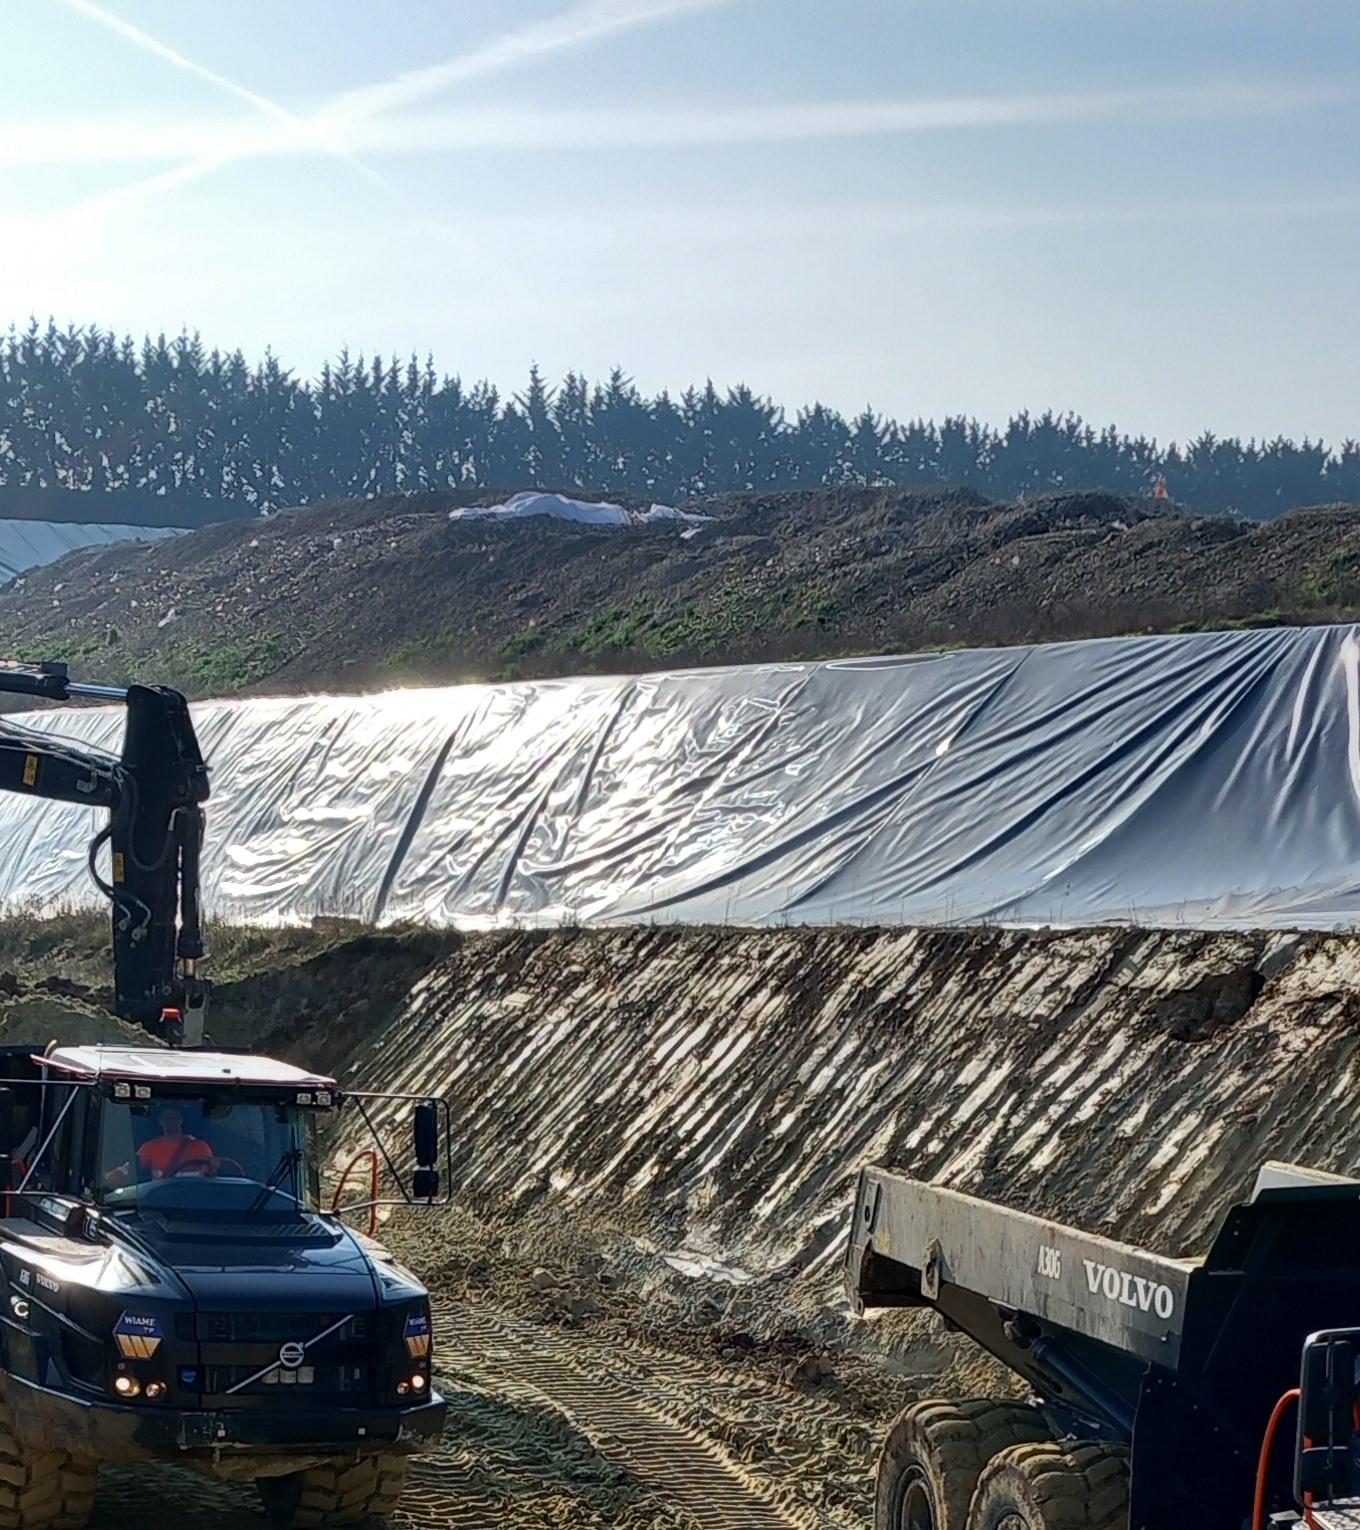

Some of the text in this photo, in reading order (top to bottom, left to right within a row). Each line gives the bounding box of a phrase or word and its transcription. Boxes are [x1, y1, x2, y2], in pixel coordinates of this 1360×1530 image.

[36, 1272, 59, 1293] VOLVO
[1038, 1245, 1174, 1319] A30G VOLVO
[124, 1315, 156, 1326] WIAME
